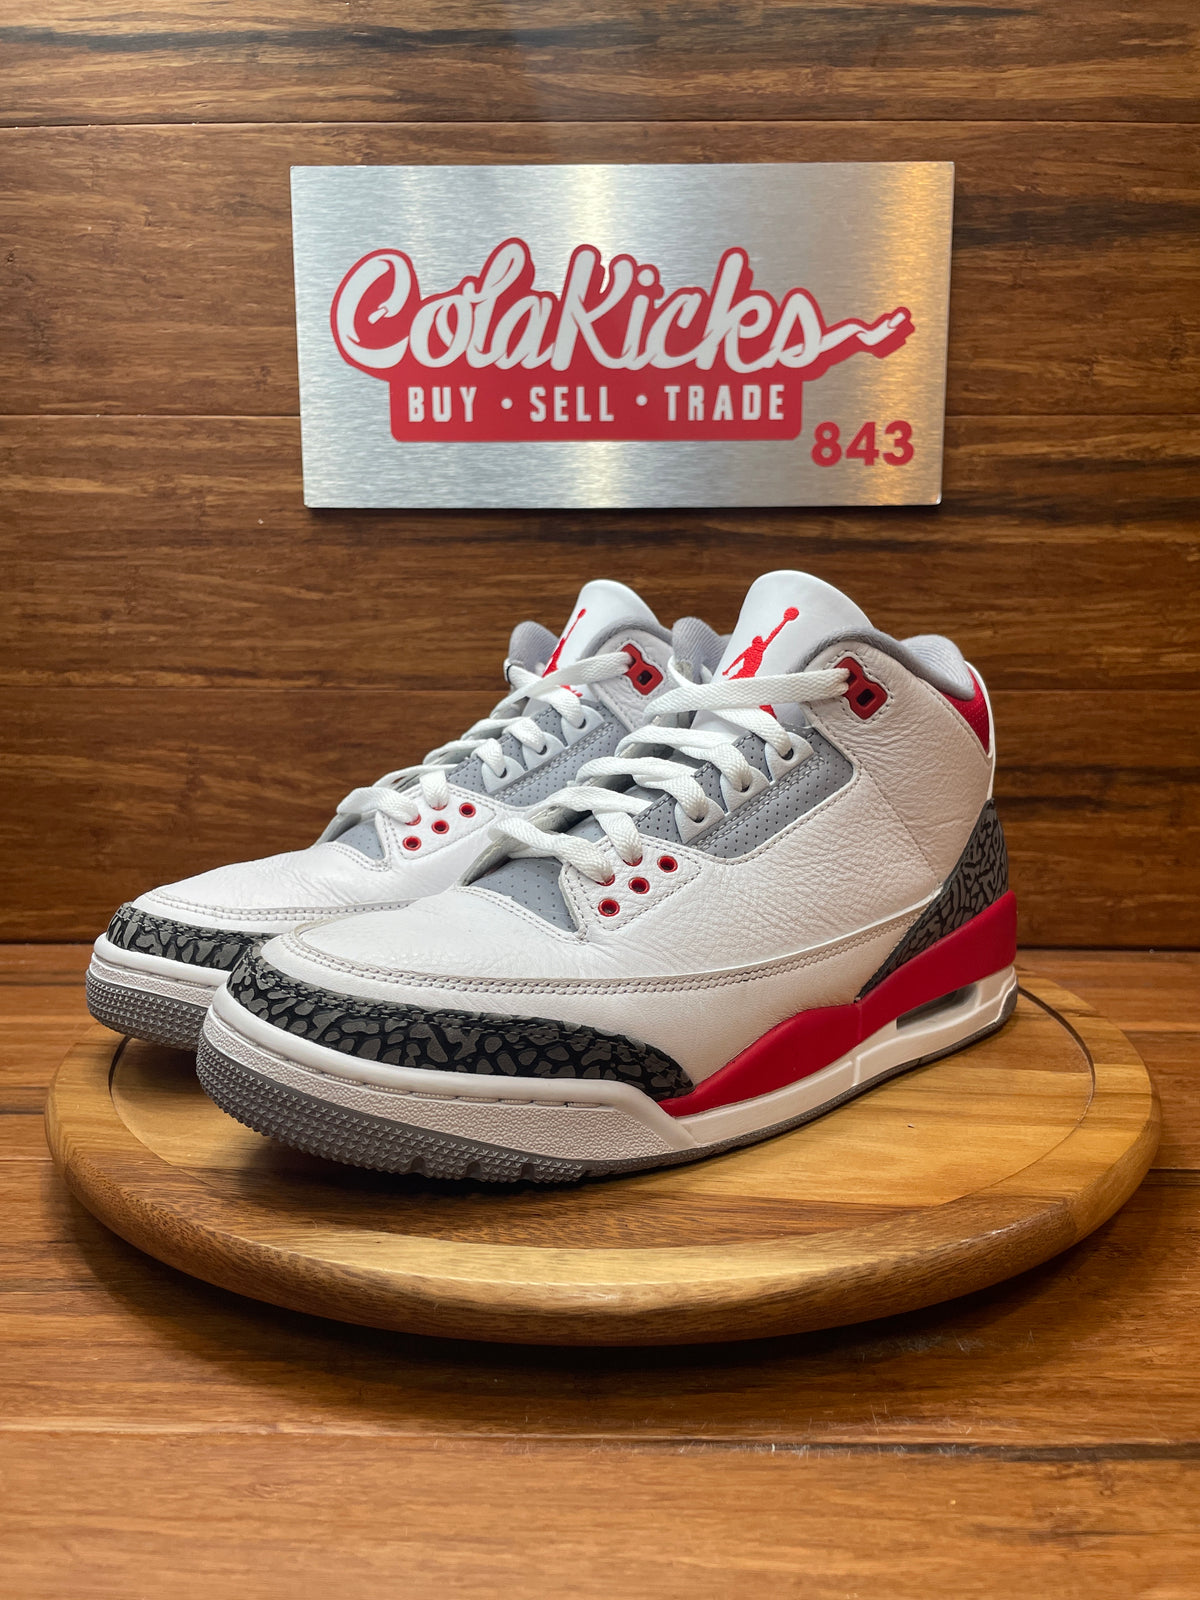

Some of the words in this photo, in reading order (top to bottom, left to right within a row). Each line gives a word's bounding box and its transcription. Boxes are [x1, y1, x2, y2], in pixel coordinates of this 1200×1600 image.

[408, 386, 477, 422] BUY
[529, 386, 615, 422] SELL
[664, 384, 786, 421] TRADE
[811, 421, 915, 467] 843
